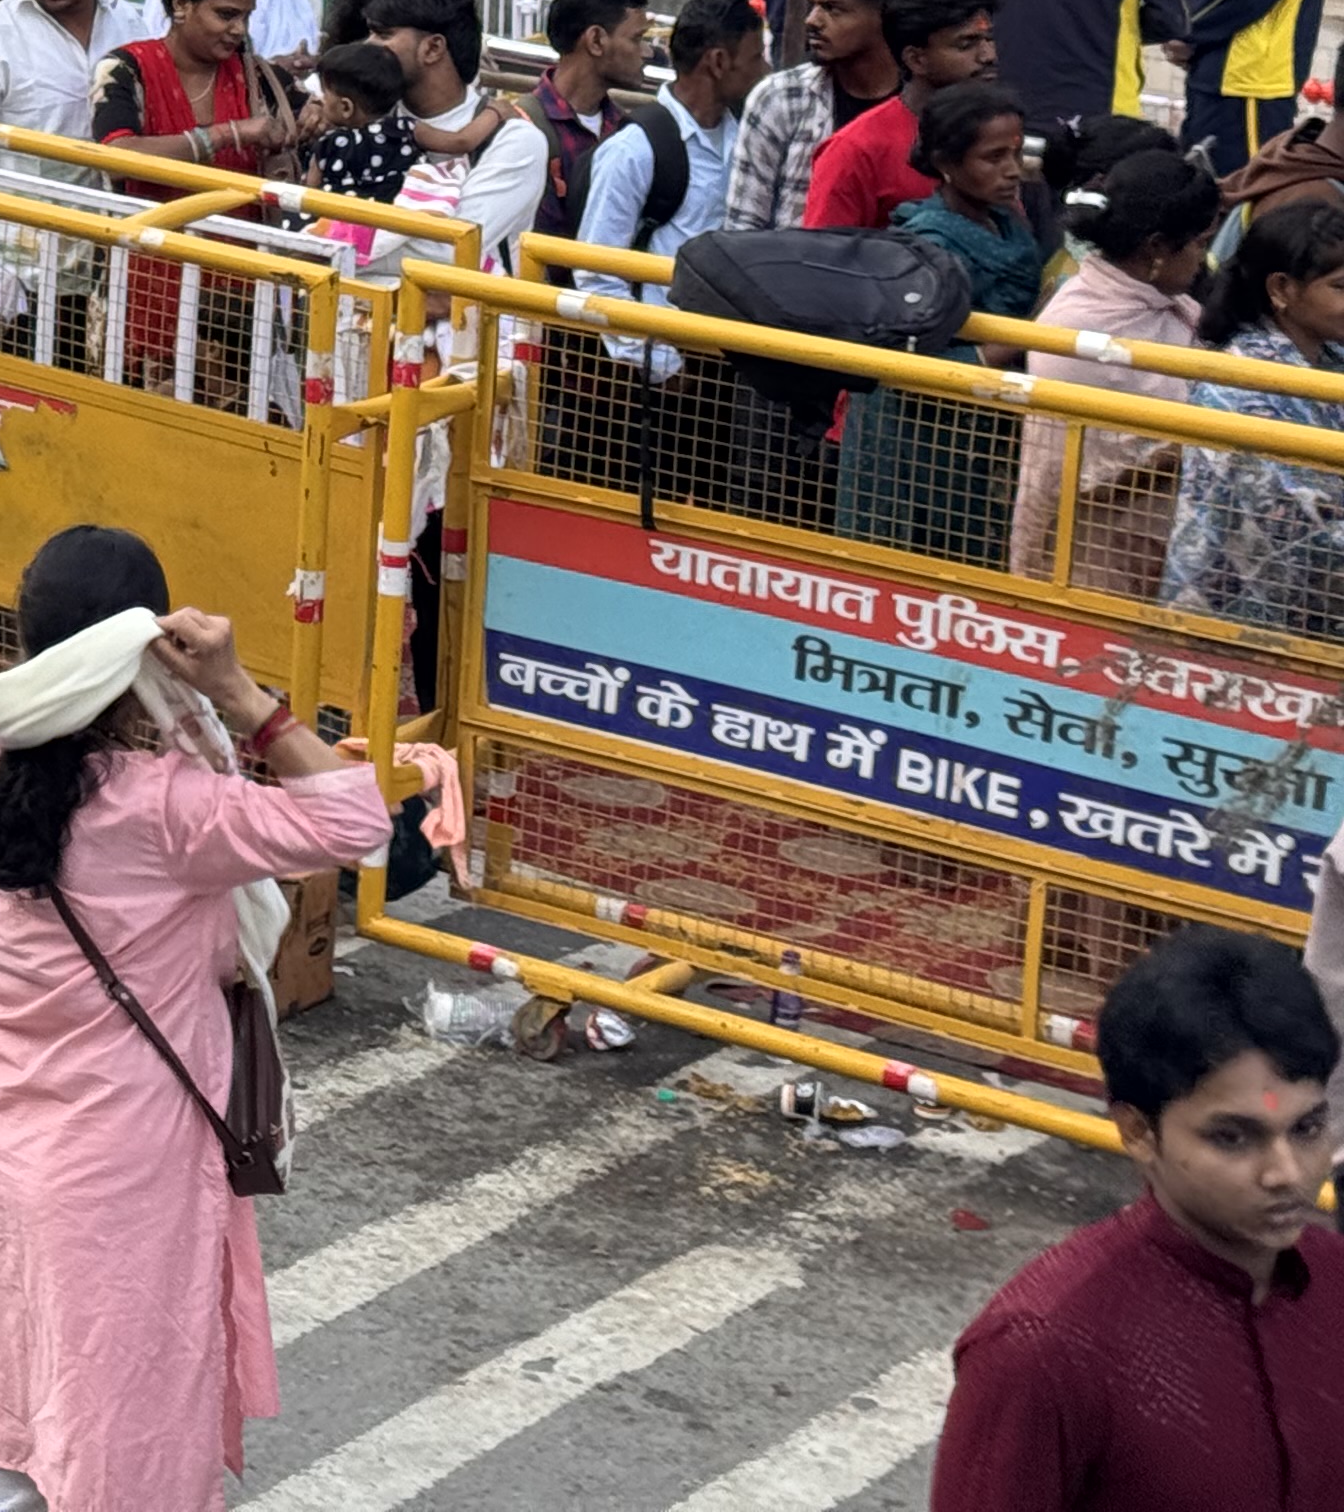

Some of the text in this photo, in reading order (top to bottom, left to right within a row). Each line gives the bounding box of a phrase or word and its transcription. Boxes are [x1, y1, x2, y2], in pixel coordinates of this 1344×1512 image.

[648, 538, 880, 625] यातायात
[498, 652, 632, 716] बच्चों
[636, 681, 700, 731] के
[711, 702, 816, 763] हाथ
[825, 723, 889, 780] में
[1057, 791, 1217, 869] खतरे
[1227, 828, 1297, 887] में
[792, 635, 981, 729] मित्रता,
[1003, 691, 1138, 770] सेवा,
